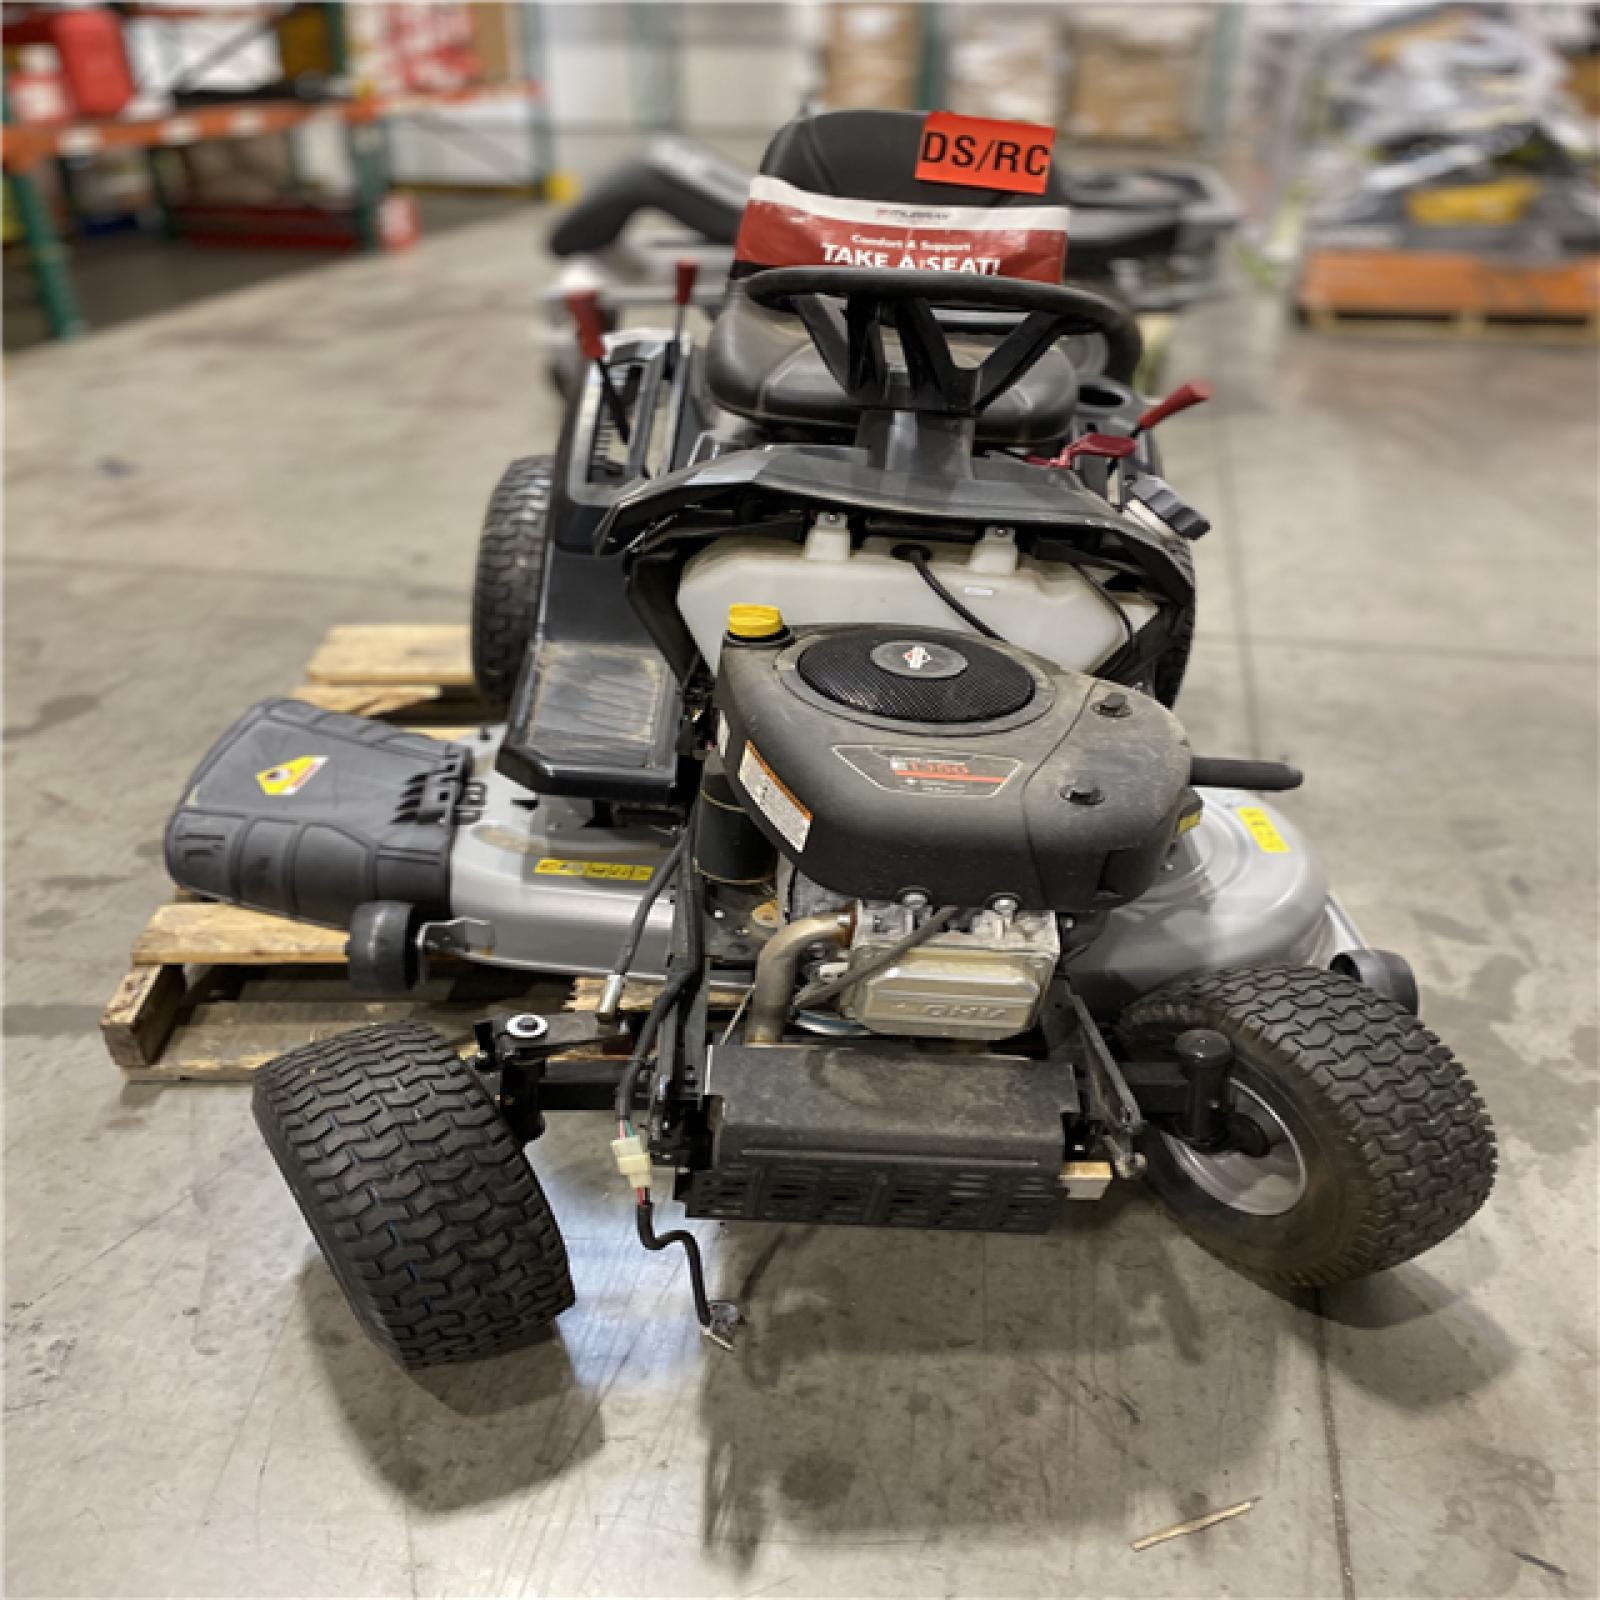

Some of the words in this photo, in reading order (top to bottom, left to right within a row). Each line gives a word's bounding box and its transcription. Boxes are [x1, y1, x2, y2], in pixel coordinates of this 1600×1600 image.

[921, 131, 1050, 177] DS/RC
[821, 243, 889, 269] TAKE
[896, 254, 916, 270] A
[926, 255, 1001, 276] SEAT!
